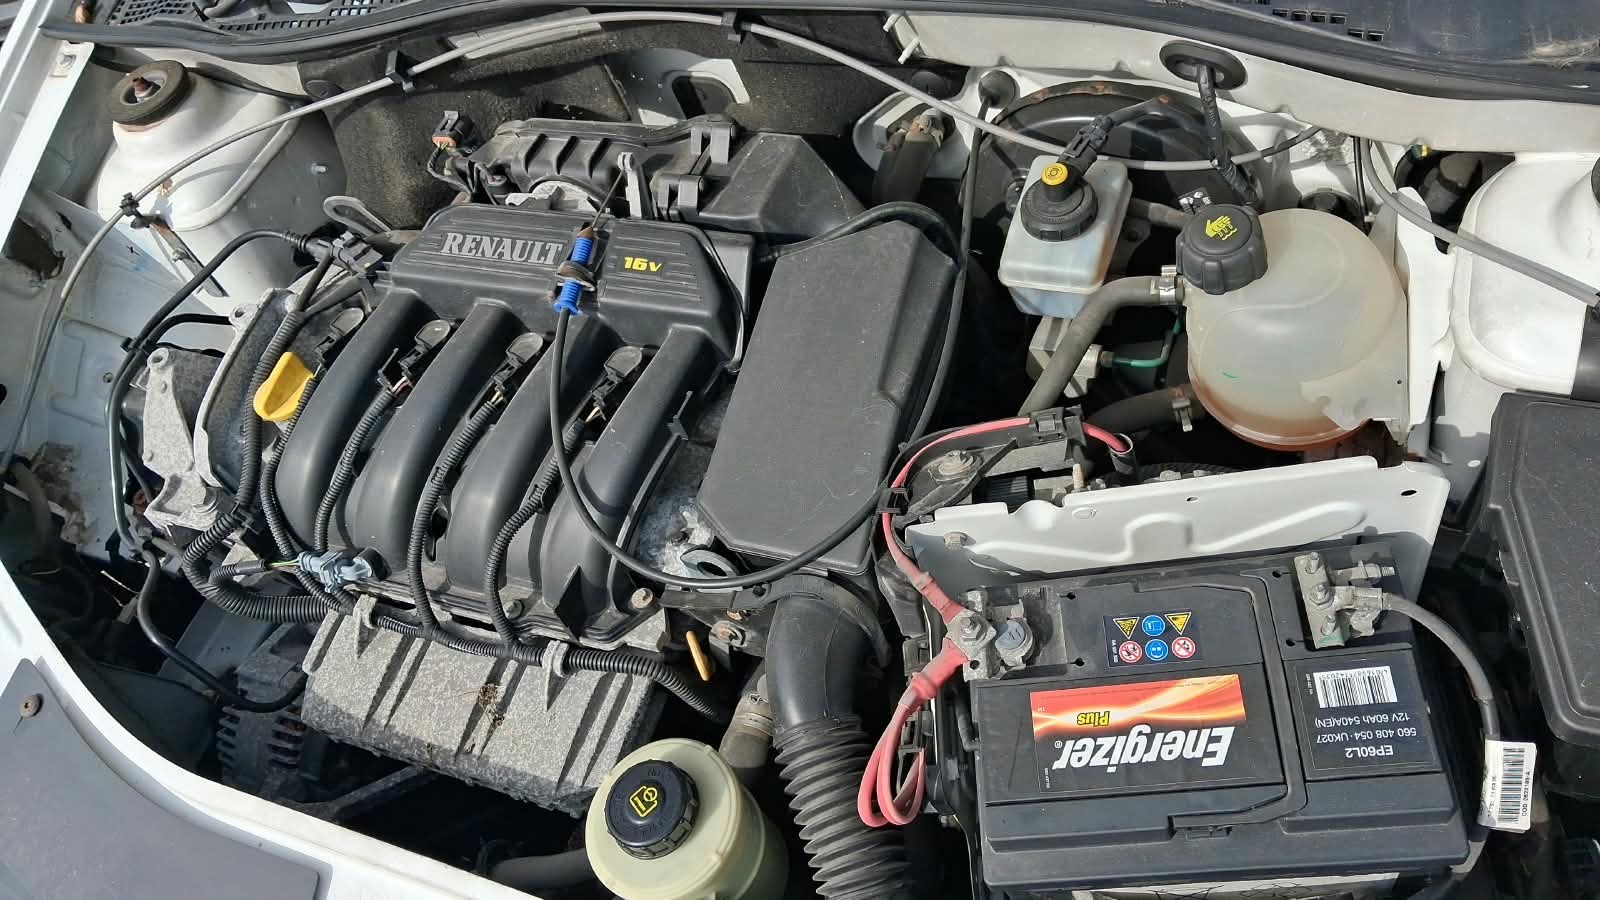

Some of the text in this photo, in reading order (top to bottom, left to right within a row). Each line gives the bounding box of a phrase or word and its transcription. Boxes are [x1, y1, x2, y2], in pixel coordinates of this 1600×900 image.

[440, 232, 564, 265] RENAULT
[1076, 711, 1111, 727] Plus
[1314, 712, 1411, 728] 12V 60Ah 540A(EN)
[1375, 729, 1395, 739] 408
[1397, 727, 1417, 737] 560
[1344, 744, 1394, 758] EP60L2
